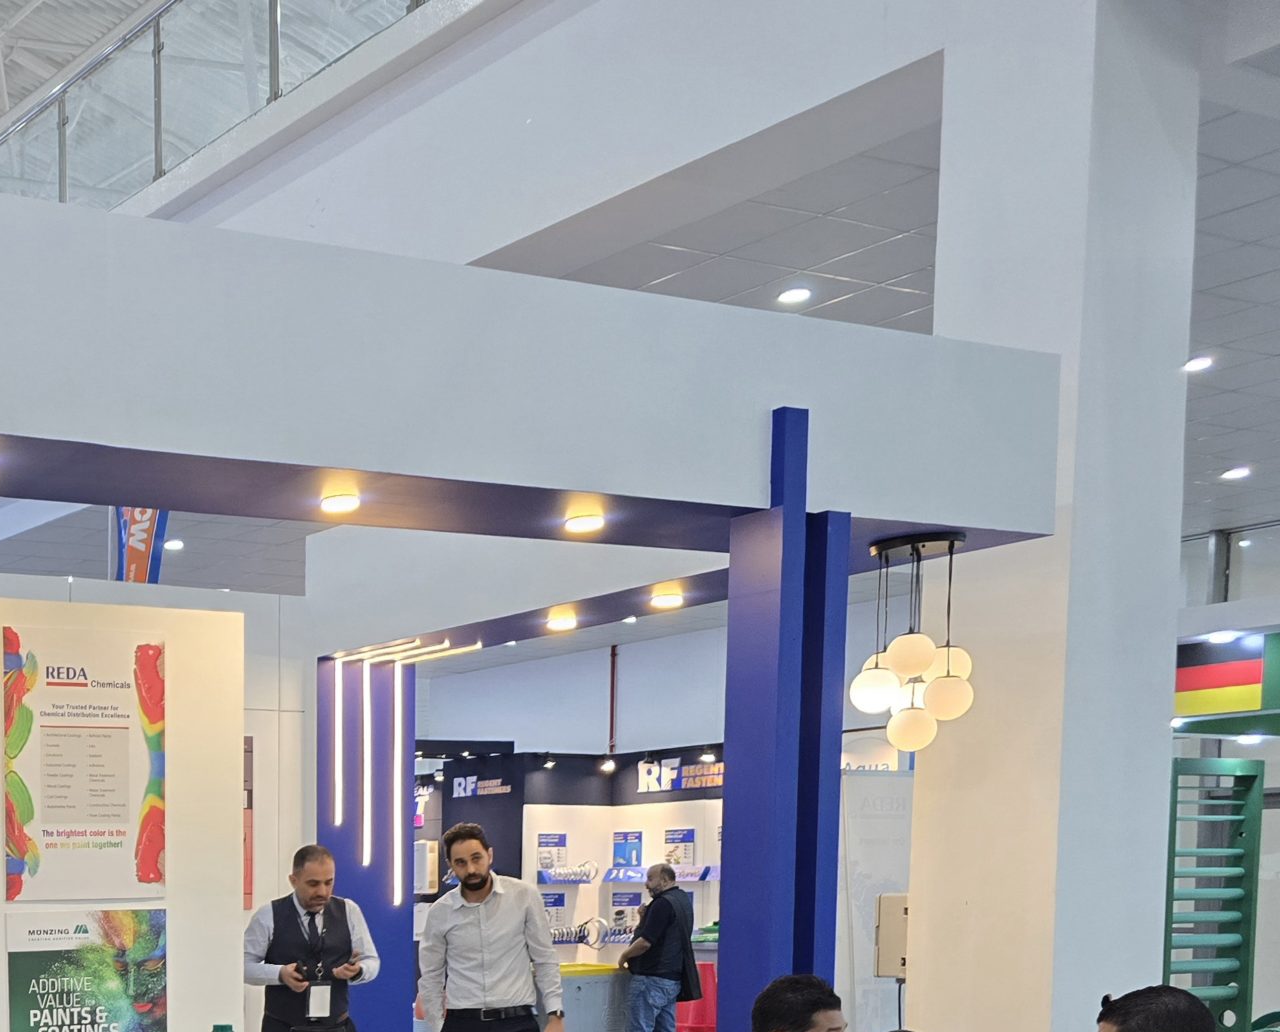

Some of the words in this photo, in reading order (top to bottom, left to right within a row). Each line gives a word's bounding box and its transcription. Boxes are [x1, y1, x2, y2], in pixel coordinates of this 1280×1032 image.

[46, 666, 88, 680] REDA
[90, 680, 130, 689] Chemicals
[637, 758, 681, 792] RF
[452, 776, 477, 798] RF
[56, 830, 87, 838] brightest
[108, 829, 113, 837] is
[116, 829, 126, 837] the
[92, 840, 123, 850] together!
[28, 976, 93, 994] ADDITIVE
[37, 993, 81, 1009] VALUE
[30, 1007, 91, 1026] PAINTS
[96, 1006, 108, 1023] &
